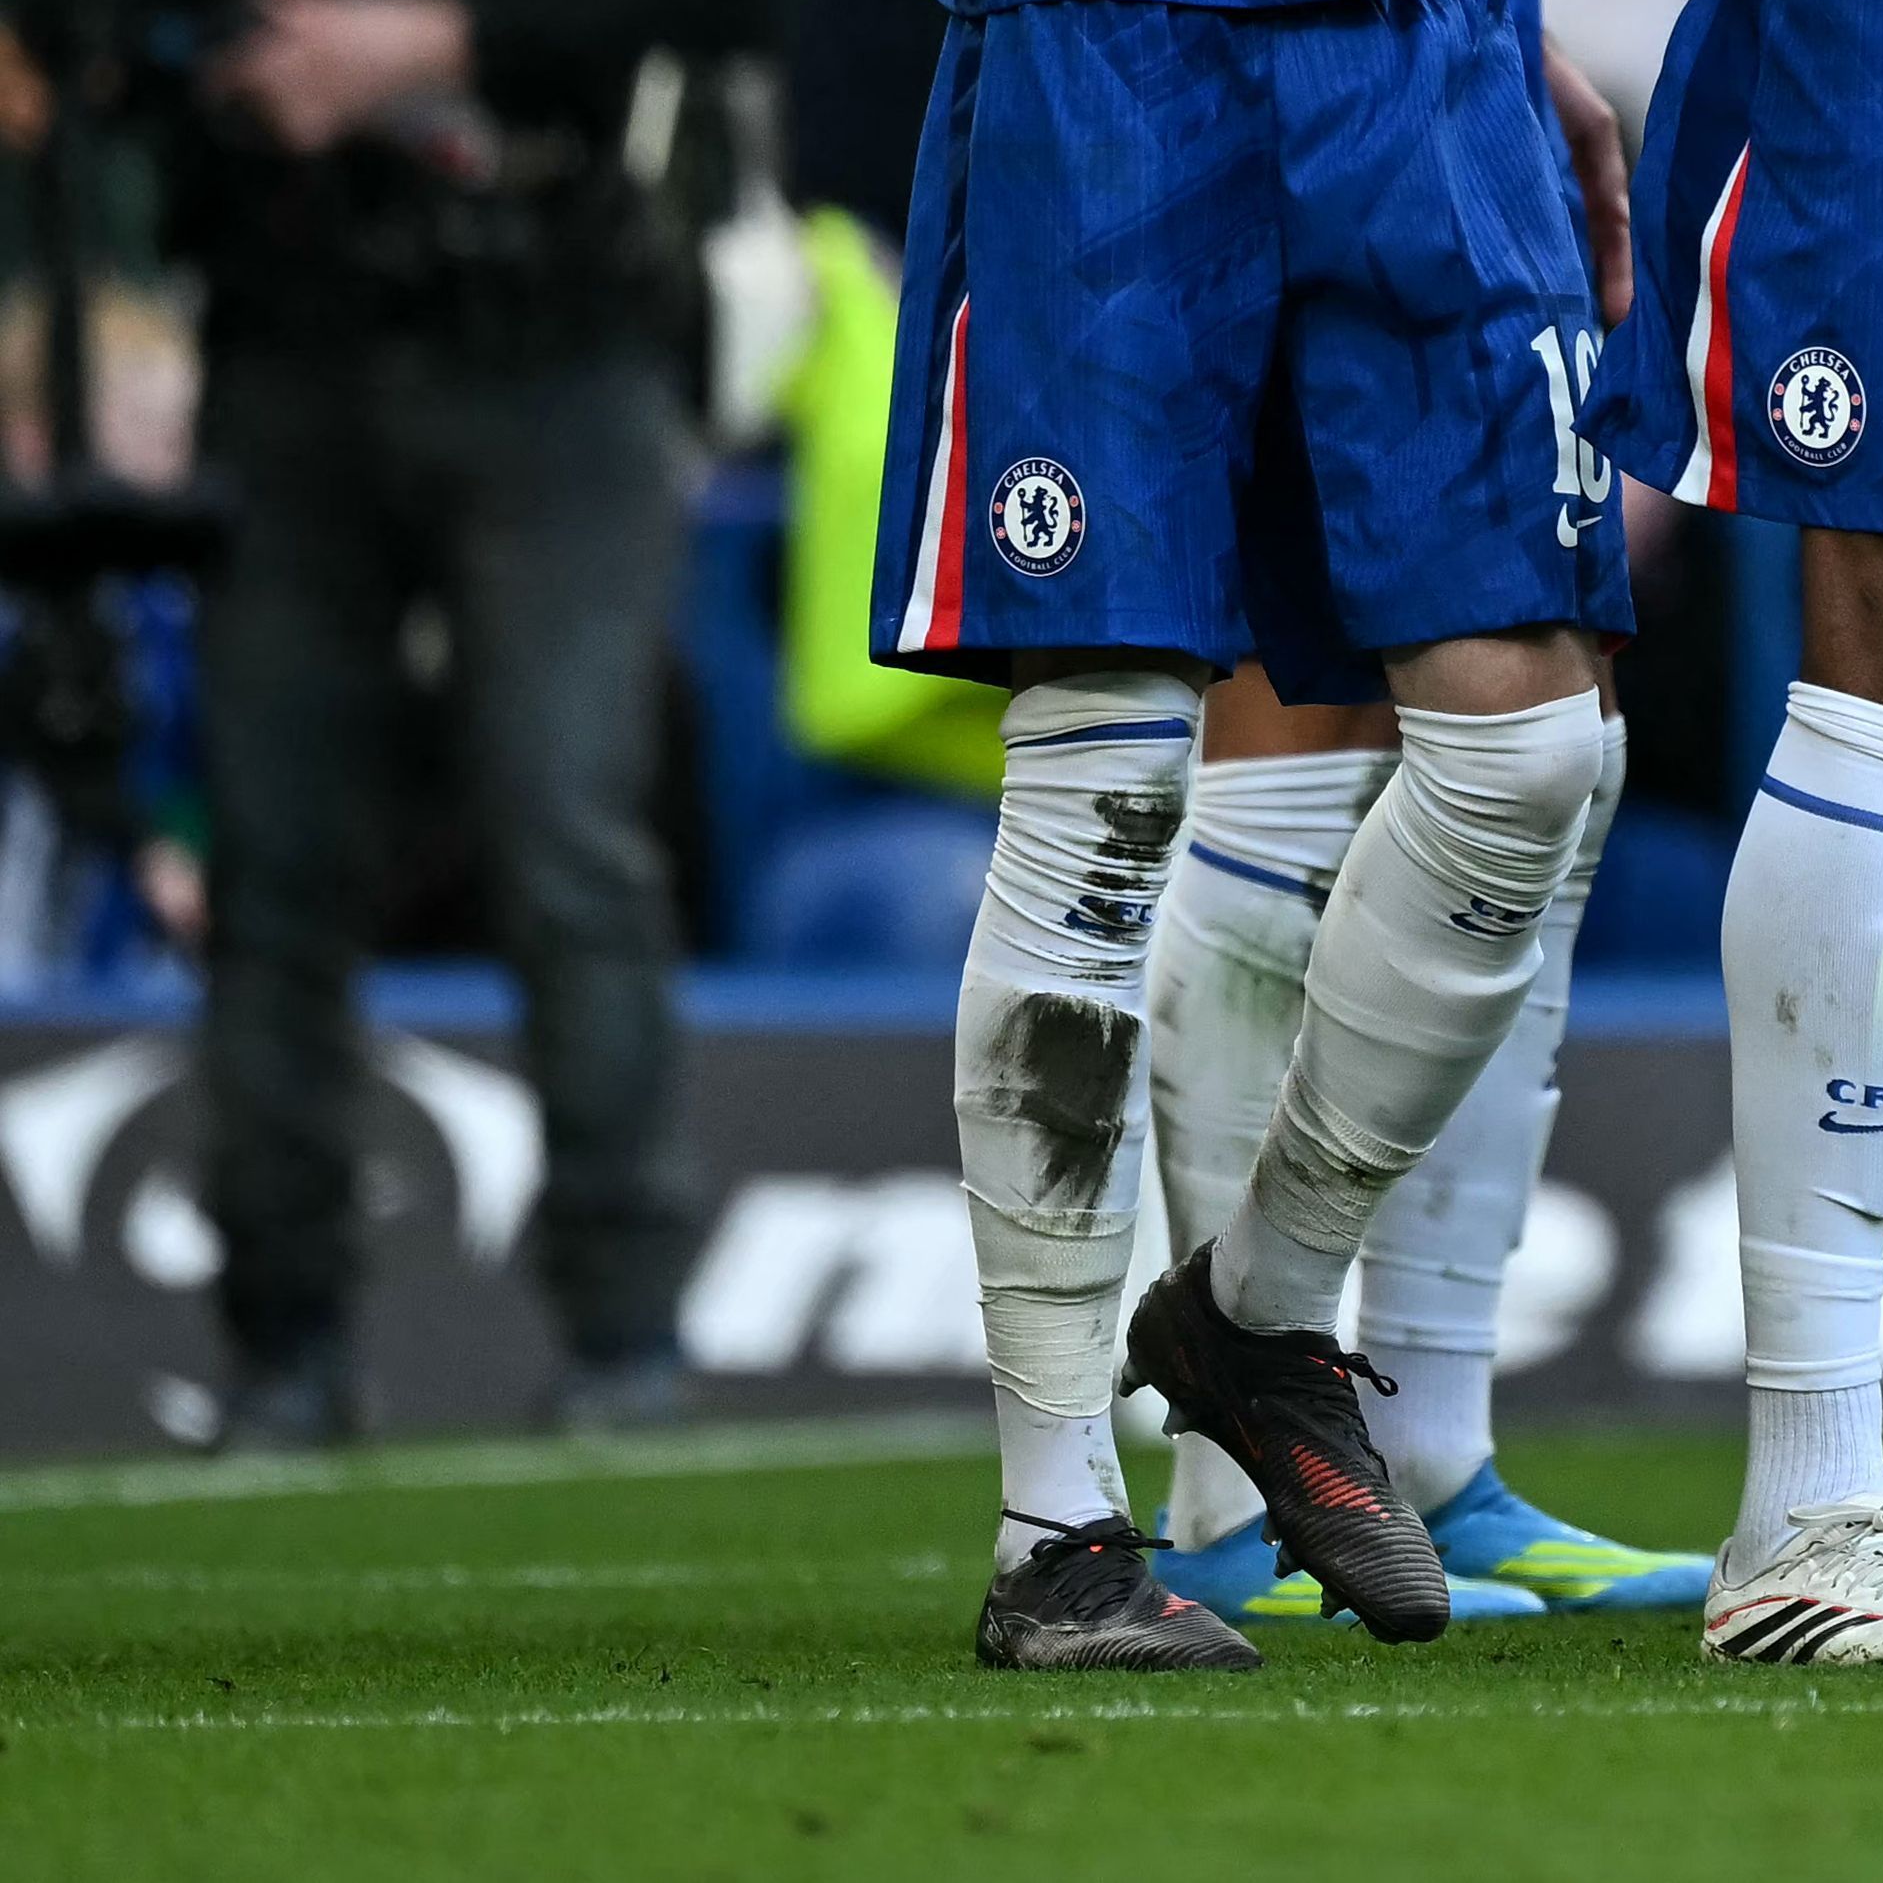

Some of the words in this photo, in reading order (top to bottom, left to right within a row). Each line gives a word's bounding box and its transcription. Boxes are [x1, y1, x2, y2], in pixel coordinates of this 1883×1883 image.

[1789, 351, 1850, 381] CHELSEA
[1827, 442, 1847, 459] CLUB
[1004, 462, 1064, 488] CHELSEA
